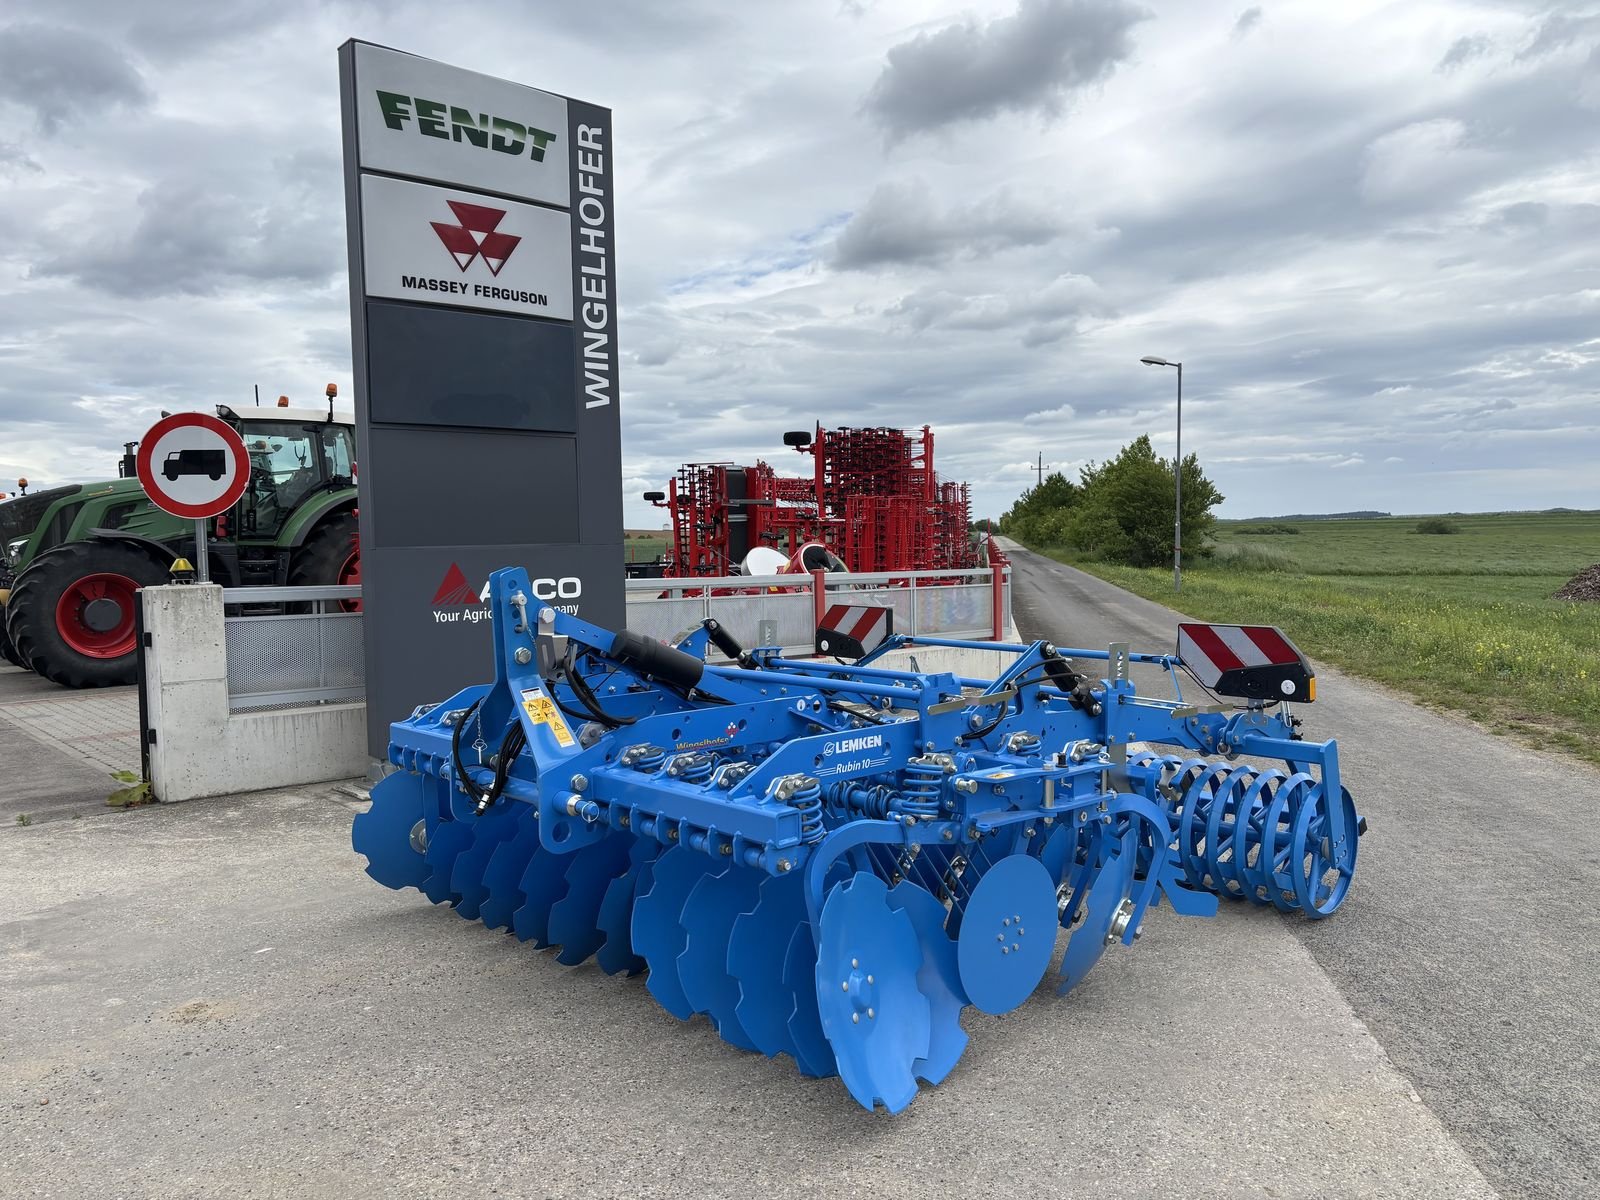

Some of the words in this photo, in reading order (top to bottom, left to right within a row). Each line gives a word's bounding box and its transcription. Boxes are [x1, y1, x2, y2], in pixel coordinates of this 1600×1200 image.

[376, 90, 557, 163] FENDT
[577, 123, 610, 409] WINGELHOFER
[402, 275, 469, 294] MASSEY
[474, 284, 548, 306] FERGUSON
[480, 577, 582, 603] ACO
[433, 610, 461, 623] Your
[835, 734, 882, 754] LEMKEN
[836, 761, 861, 774] Rubin
[862, 758, 871, 769] 10
